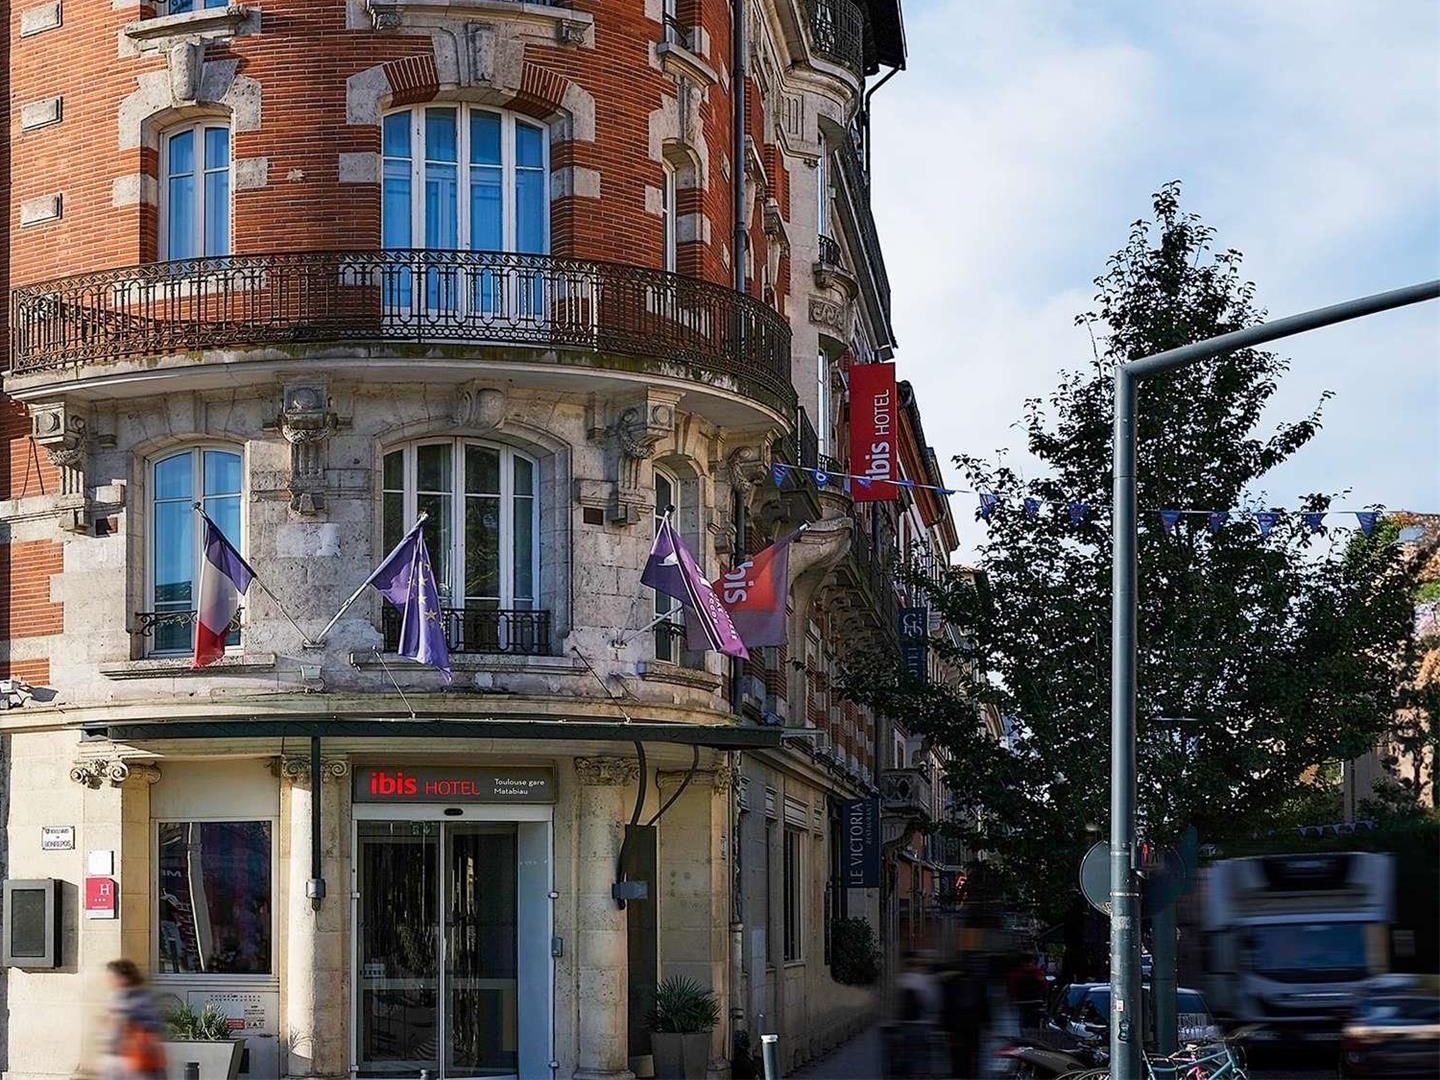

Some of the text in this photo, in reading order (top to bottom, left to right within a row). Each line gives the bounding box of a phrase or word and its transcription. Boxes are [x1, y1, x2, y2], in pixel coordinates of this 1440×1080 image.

[864, 388, 891, 482] ibis HOTEL
[723, 560, 754, 604] bis
[369, 771, 481, 796] ibis HOTEL
[493, 787, 528, 795] Matabiau
[494, 777, 545, 788] Toulouse gare
[849, 802, 864, 886] LE VICTORIA
